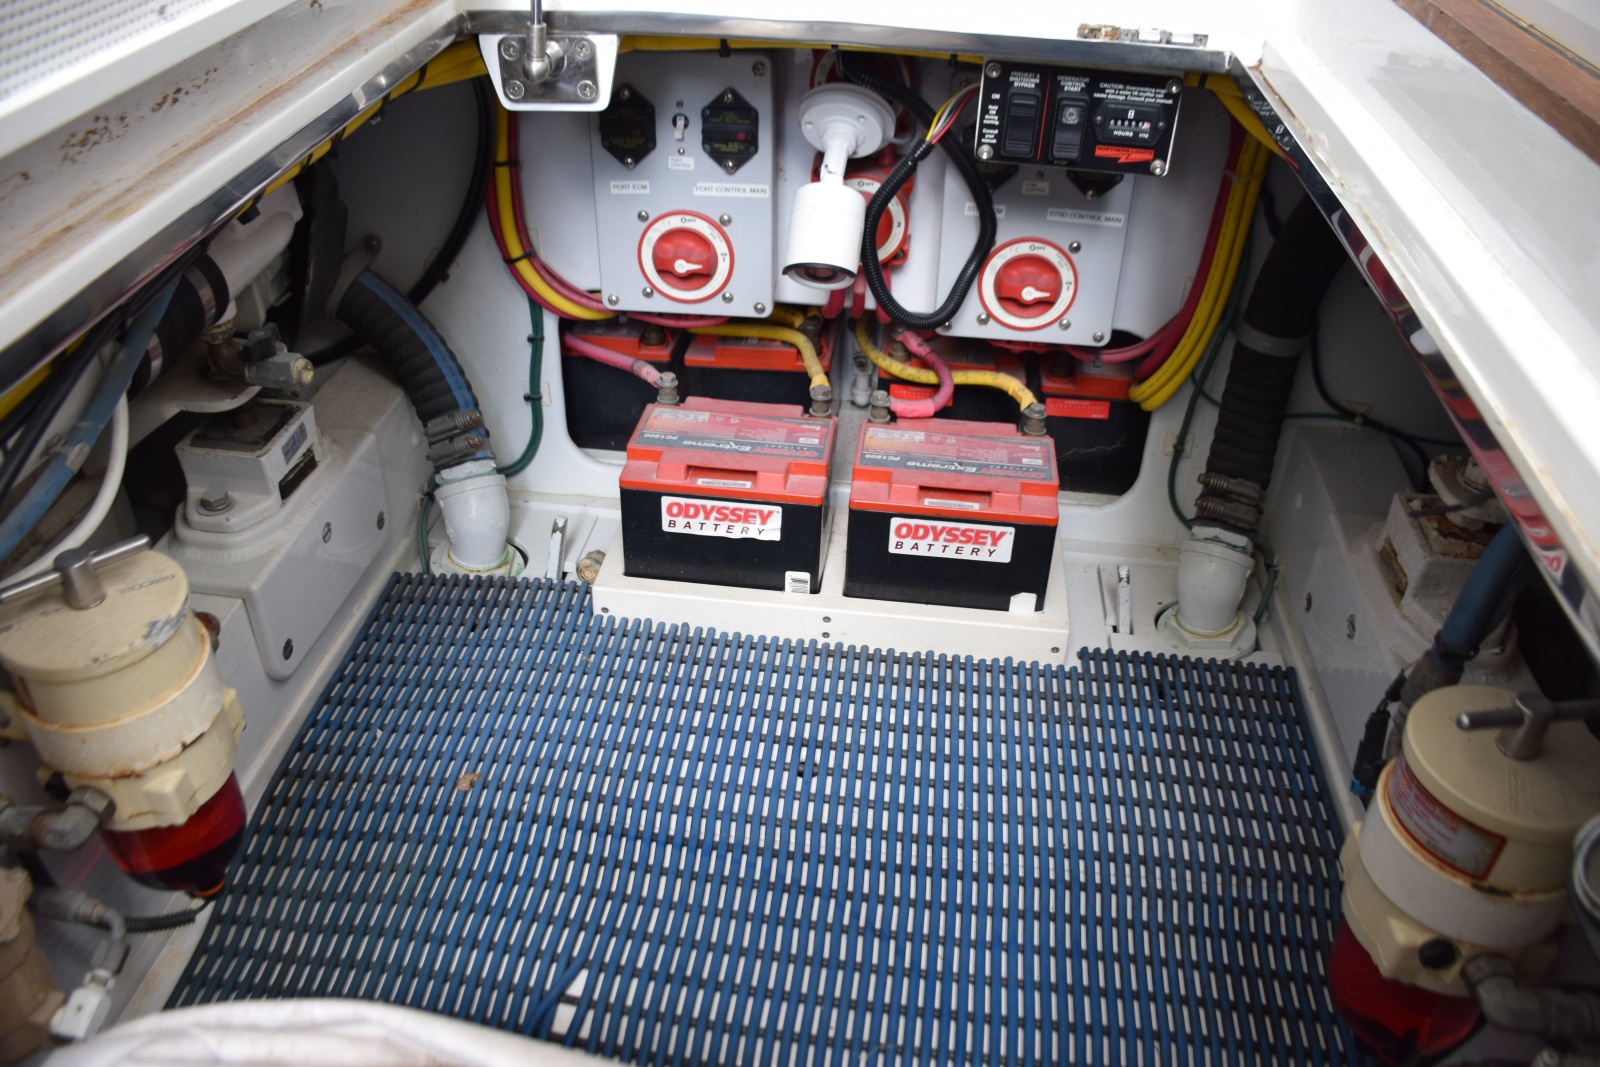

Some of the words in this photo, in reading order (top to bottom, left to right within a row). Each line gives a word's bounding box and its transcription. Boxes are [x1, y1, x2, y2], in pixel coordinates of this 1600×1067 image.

[1009, 76, 1040, 84] SHUTDOWN
[1069, 212, 1101, 221] CONTROL
[1104, 216, 1122, 224] MAIN
[643, 433, 679, 441] PC1200
[683, 439, 751, 452] Extreme
[752, 446, 819, 457] ODYSSEY
[865, 453, 901, 461] PC1200
[906, 461, 977, 473] Extreme
[980, 467, 1046, 479] ODYSSEY
[666, 501, 775, 526] ODYSSEY
[668, 519, 766, 536] BATTERY
[894, 522, 1008, 547] ODYSSEY
[894, 541, 996, 557] BATTERY
